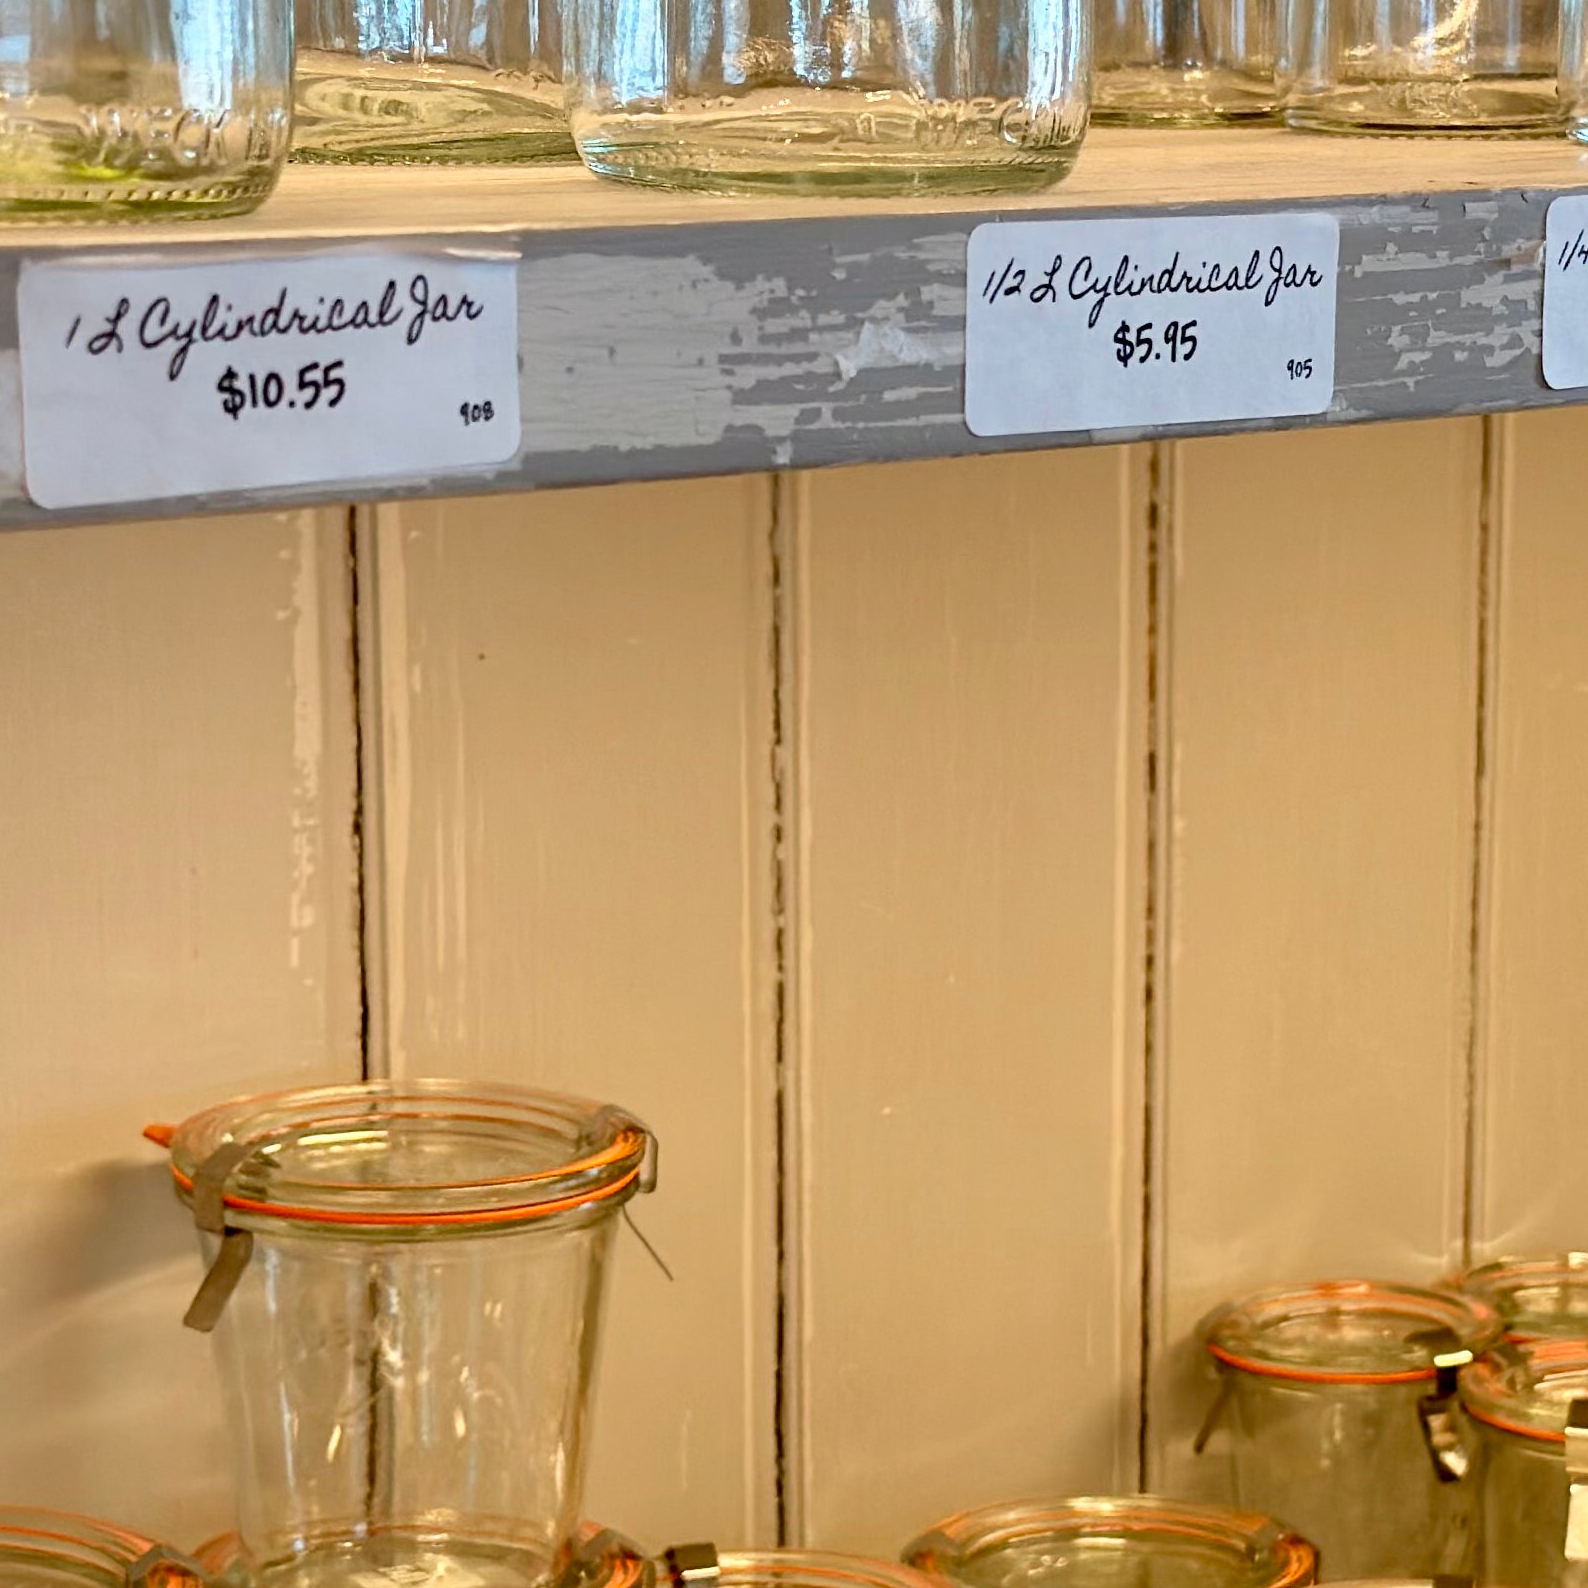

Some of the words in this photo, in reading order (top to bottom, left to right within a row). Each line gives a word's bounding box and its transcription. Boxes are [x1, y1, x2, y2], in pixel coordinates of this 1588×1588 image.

[981, 257, 1026, 305] 1/2
[1030, 254, 1063, 303] L
[1068, 250, 1263, 329] Cylindrical
[1264, 245, 1324, 307] Jar
[65, 315, 81, 349] 1
[87, 296, 130, 355] L
[140, 279, 404, 381] Cylindrical
[406, 273, 484, 346] Jar
[1112, 319, 1199, 368] $5.95
[216, 359, 346, 420] $10.55
[1286, 358, 1313, 380] 905
